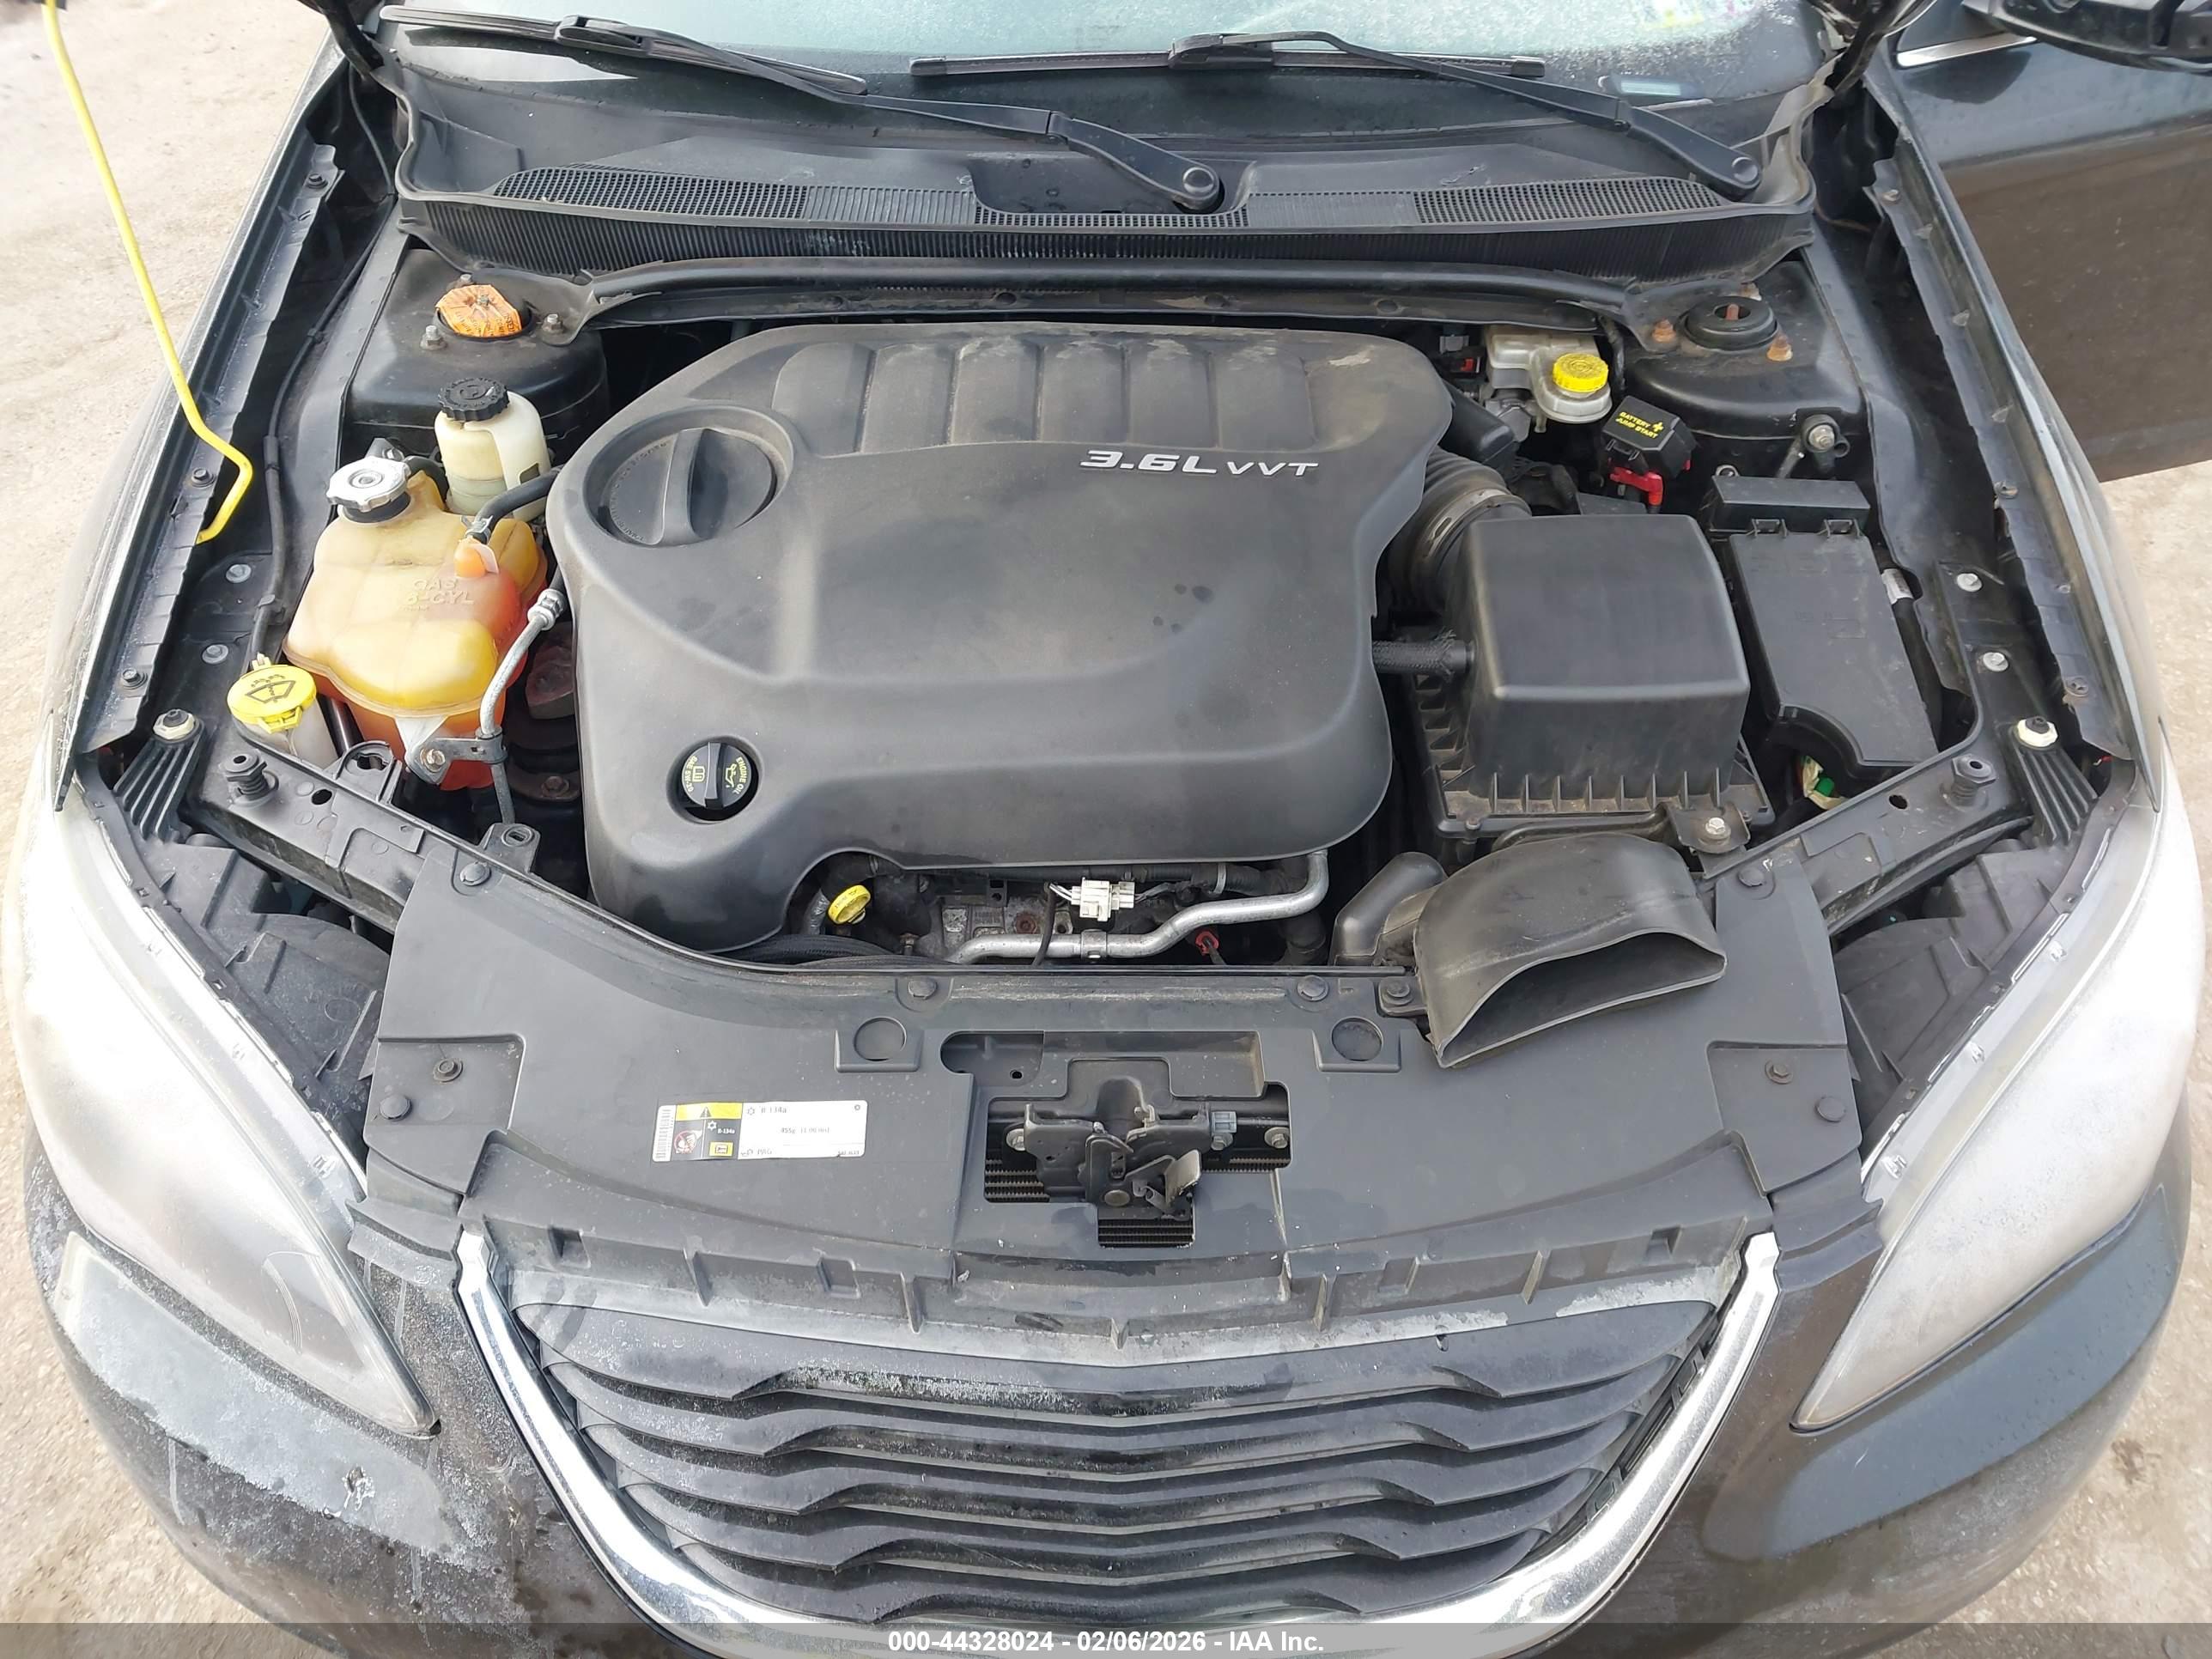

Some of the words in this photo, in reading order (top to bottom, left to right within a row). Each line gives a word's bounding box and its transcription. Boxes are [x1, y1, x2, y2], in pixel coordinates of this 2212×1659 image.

[1615, 417, 1636, 428] JUMP
[1635, 426, 1658, 438] START
[1619, 411, 1650, 428] BATTERY
[1080, 450, 1217, 473] 3.6L
[1227, 461, 1319, 476] VVT
[413, 578, 459, 591] GAS
[736, 757, 747, 783] ENGINE
[732, 783, 744, 794] OIL
